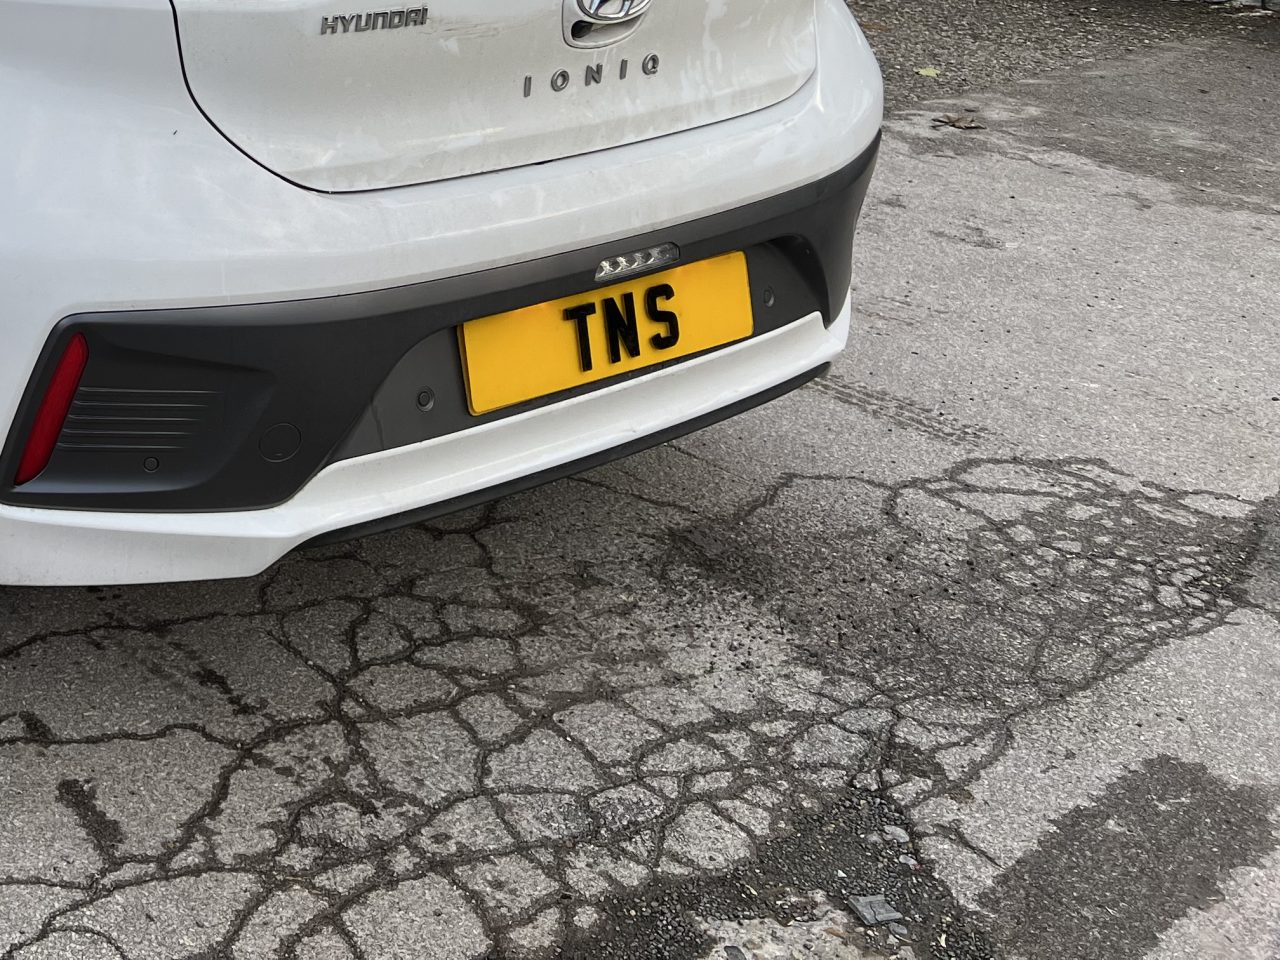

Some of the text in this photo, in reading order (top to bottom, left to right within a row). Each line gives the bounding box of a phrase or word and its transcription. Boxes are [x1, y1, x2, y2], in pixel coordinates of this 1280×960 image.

[320, 6, 428, 35] HYUNDAI
[523, 53, 660, 98] IONIQ
[562, 283, 680, 372] TNS
